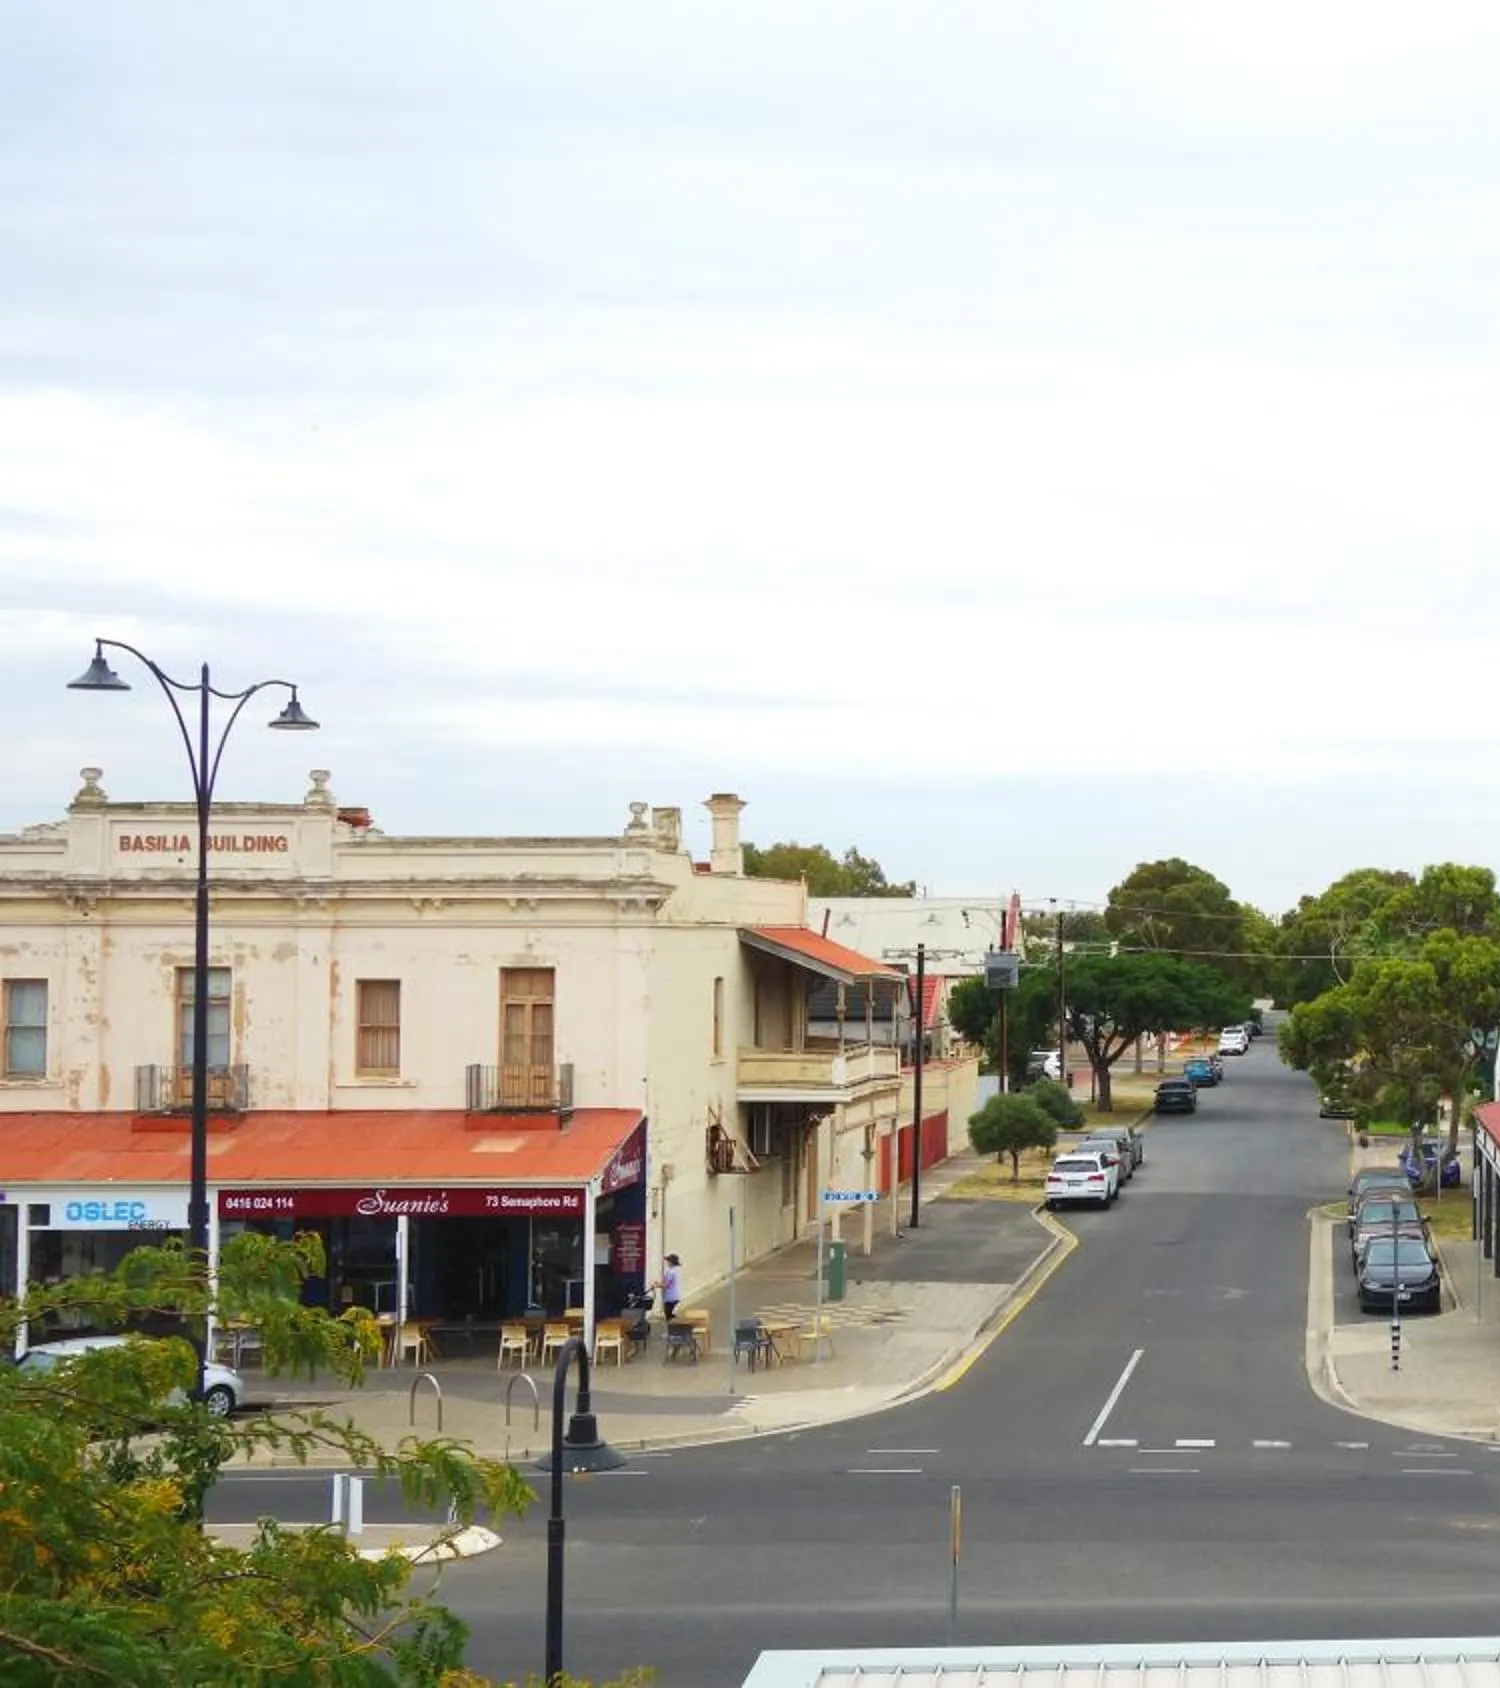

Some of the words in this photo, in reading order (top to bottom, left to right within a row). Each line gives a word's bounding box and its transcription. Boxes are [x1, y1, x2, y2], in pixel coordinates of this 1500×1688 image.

[119, 835, 191, 852] BASILIA
[202, 835, 288, 852] BUILDING
[253, 1197, 273, 1209] 024
[276, 1197, 294, 1209] 114
[356, 1190, 450, 1215] Suanie's
[486, 1195, 499, 1207] 73
[501, 1195, 561, 1210] Semaphore
[563, 1195, 579, 1207] Rd
